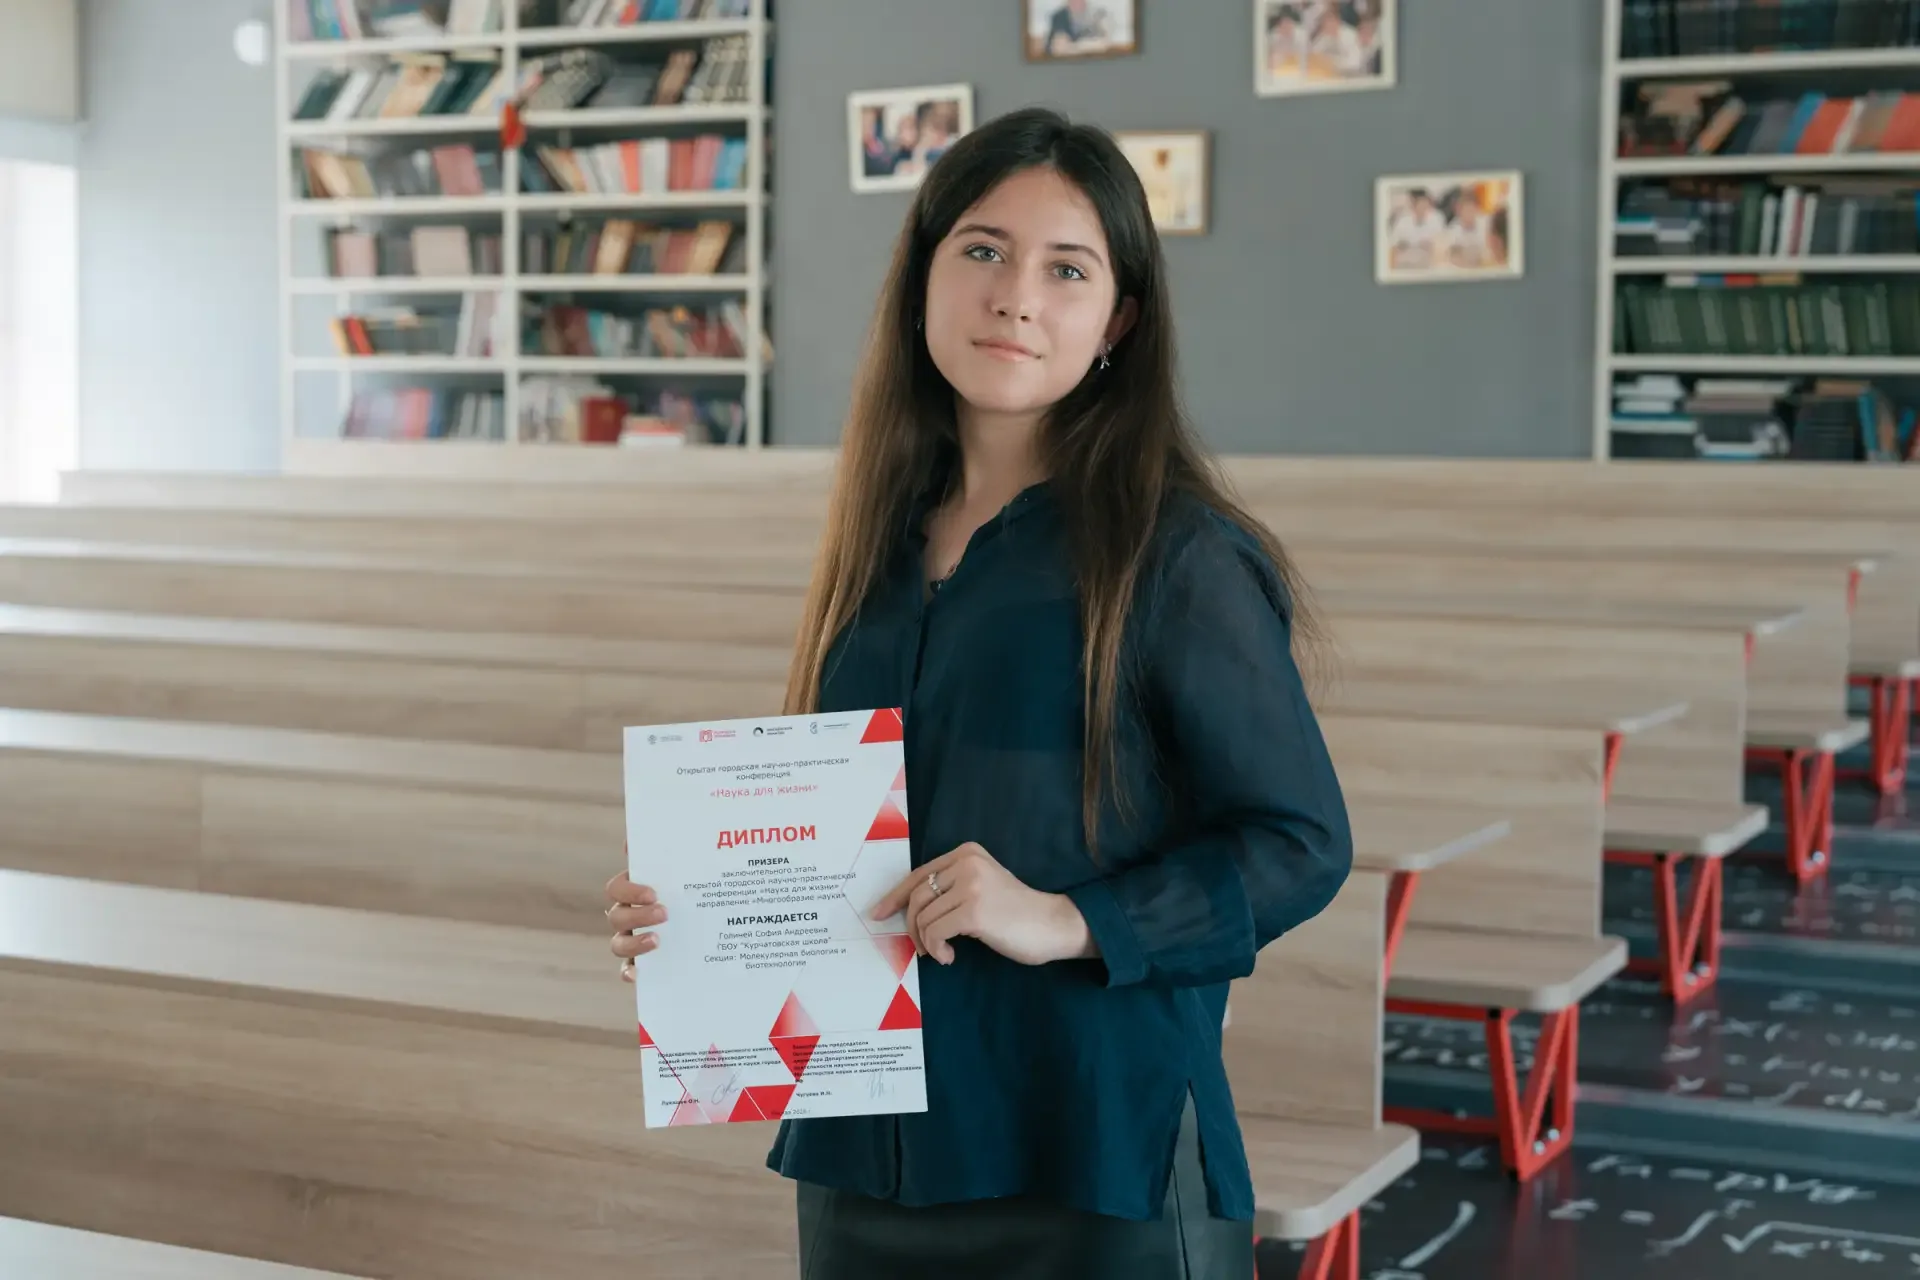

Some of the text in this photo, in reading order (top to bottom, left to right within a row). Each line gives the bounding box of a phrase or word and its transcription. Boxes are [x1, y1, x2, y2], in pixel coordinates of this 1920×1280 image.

[676, 766, 716, 776] Открытая
[718, 763, 760, 774] городская
[736, 771, 791, 782] конференция
[709, 787, 750, 799] «Наука
[753, 785, 774, 799] для
[717, 824, 817, 849] ДИПЛОМ
[748, 857, 790, 867] ПРИЗЕРА
[683, 881, 722, 891] открытой
[727, 912, 819, 926] НАГРАЖДАЕТСЯ
